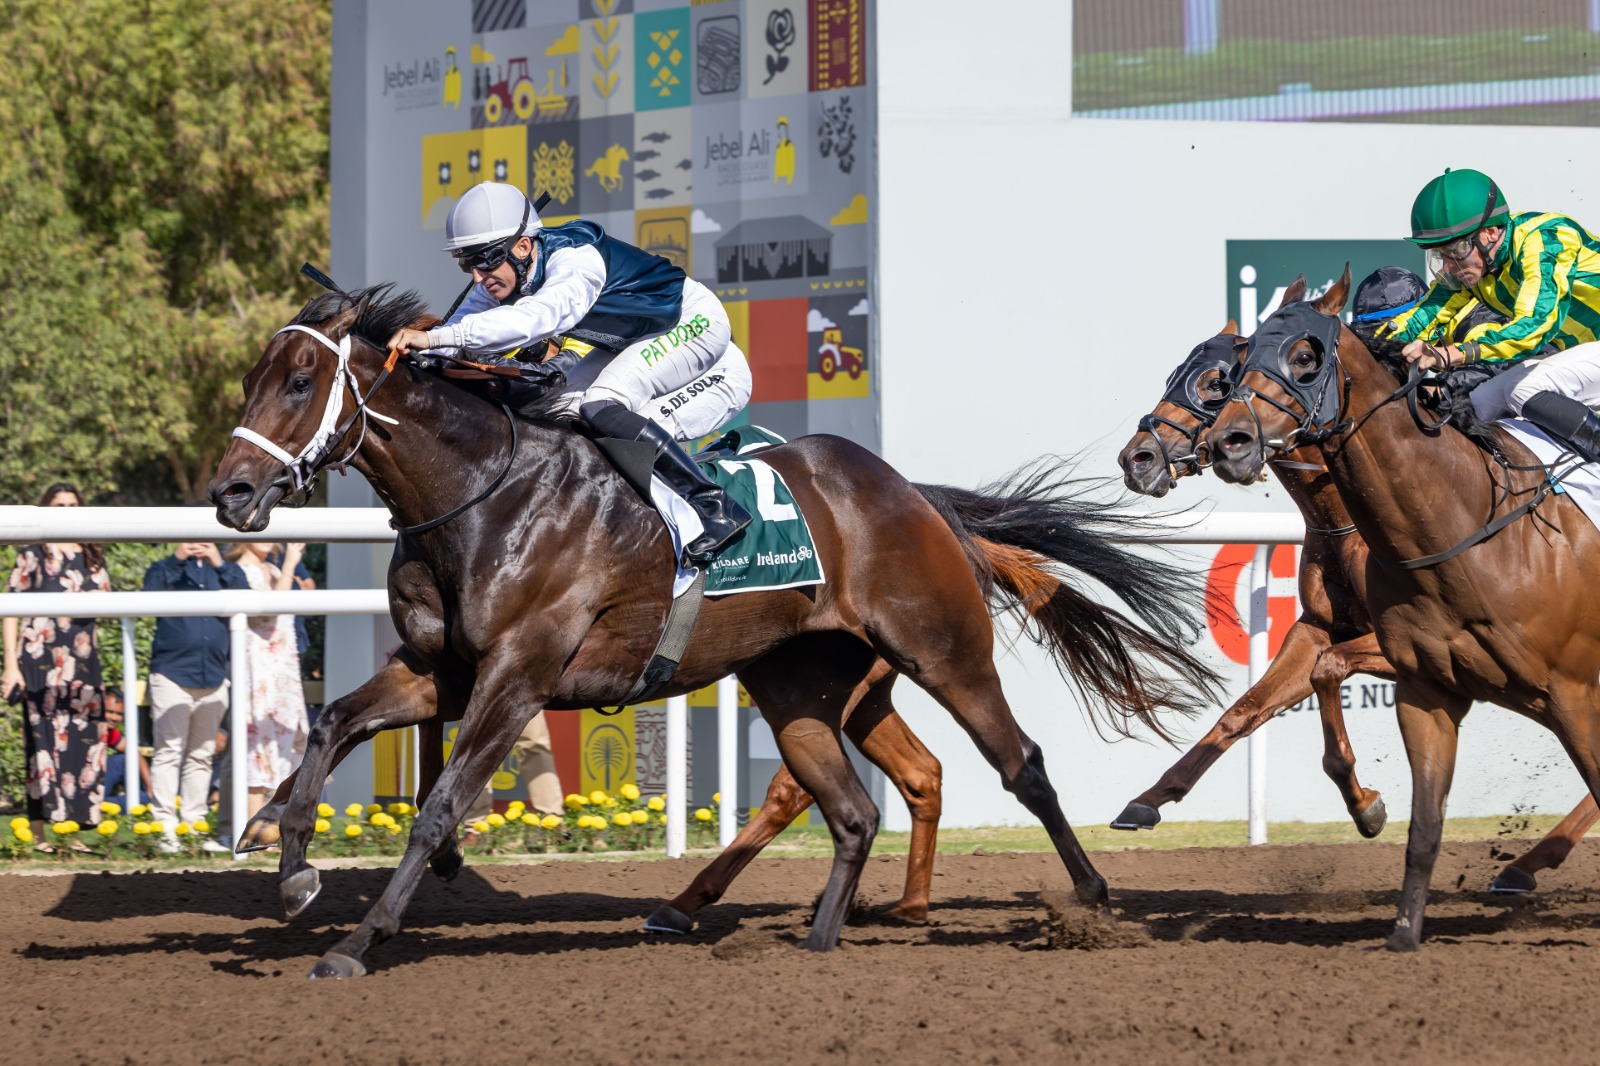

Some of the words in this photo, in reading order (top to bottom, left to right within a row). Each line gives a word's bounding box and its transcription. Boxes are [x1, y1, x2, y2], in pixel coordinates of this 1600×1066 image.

[382, 59, 419, 96] Jebel
[421, 57, 440, 83] Ali
[704, 130, 743, 169] Jebel
[747, 128, 770, 157] Ali
[640, 337, 669, 368] PAT
[668, 392, 690, 410] DE
[711, 555, 750, 570] KILDARE
[756, 549, 798, 566] Ireland
